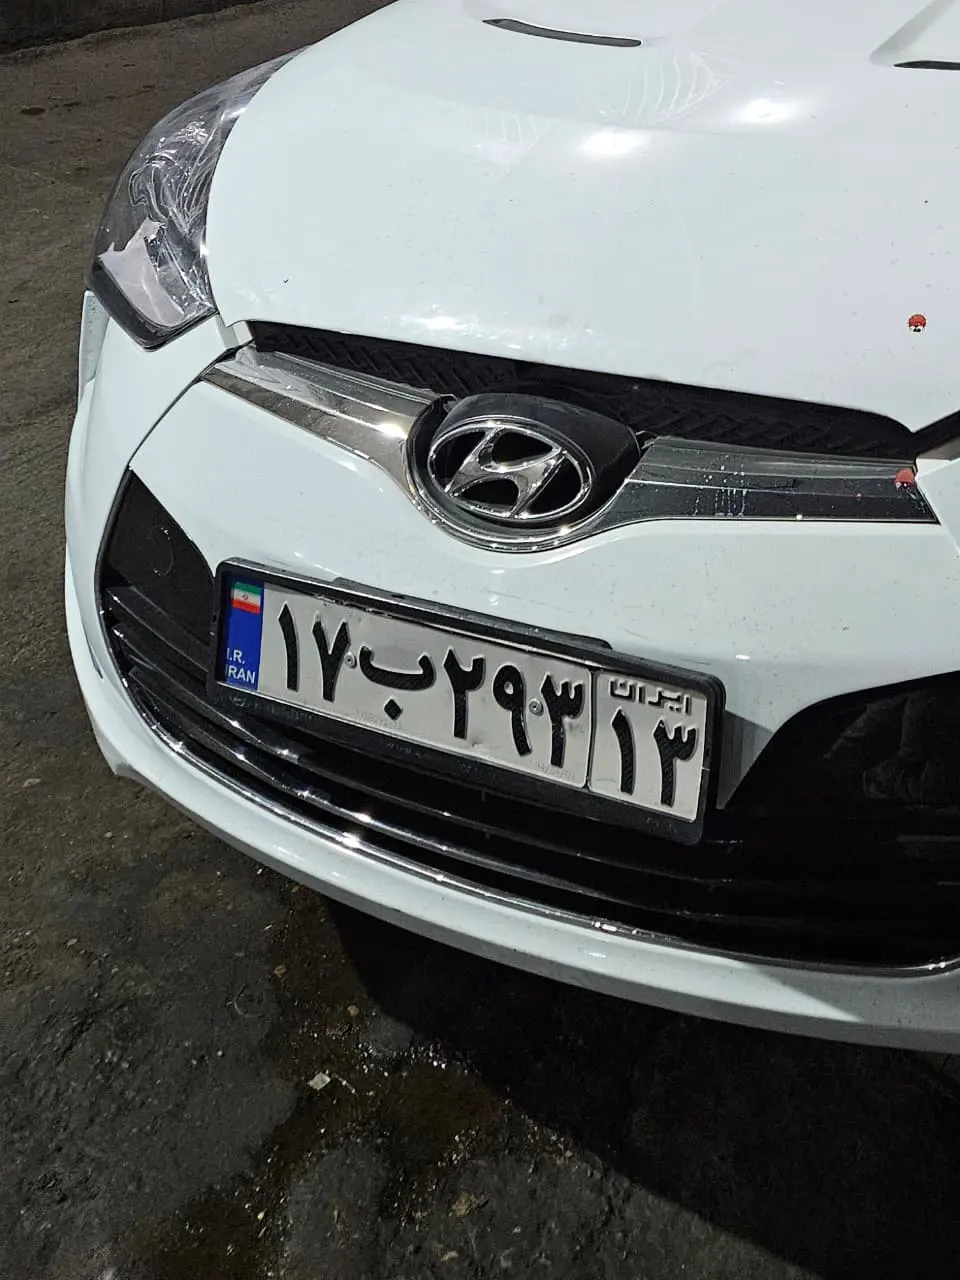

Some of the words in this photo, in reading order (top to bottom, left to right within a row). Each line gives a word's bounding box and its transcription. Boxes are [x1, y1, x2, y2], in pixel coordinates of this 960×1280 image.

[226, 647, 246, 665] I.R.
[225, 664, 256, 685] IRAN
[609, 680, 692, 714] ایران
[611, 707, 697, 807] ۱۳
